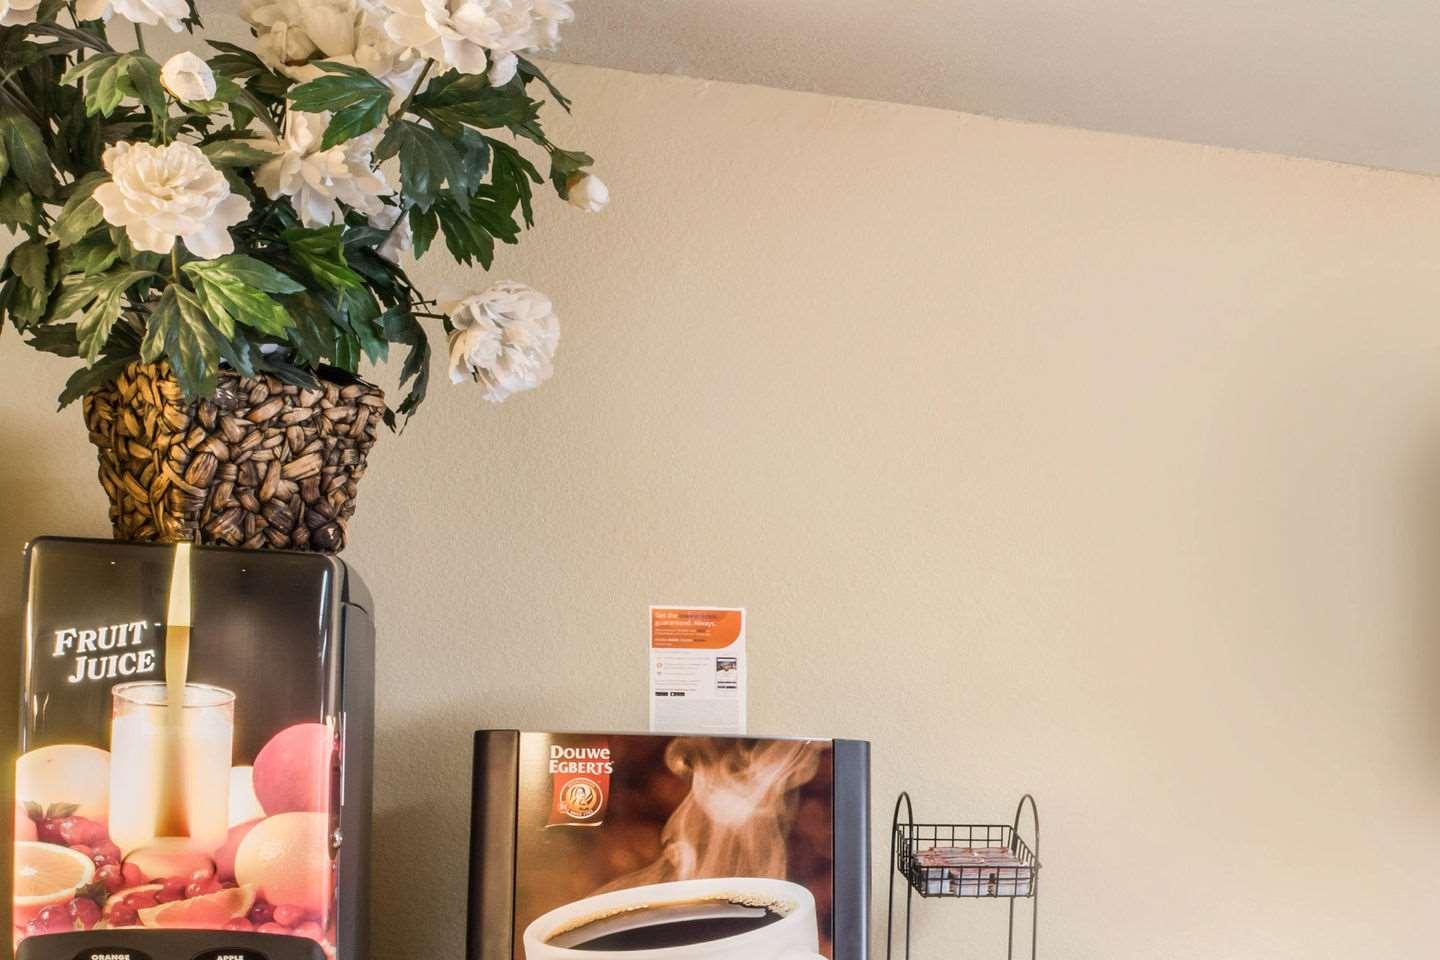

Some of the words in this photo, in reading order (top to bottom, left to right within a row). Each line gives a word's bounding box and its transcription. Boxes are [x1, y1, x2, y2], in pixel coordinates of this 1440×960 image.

[52, 620, 148, 657] FRUIT
[68, 650, 156, 683] JUICE
[549, 760, 614, 775] EGBERTS
